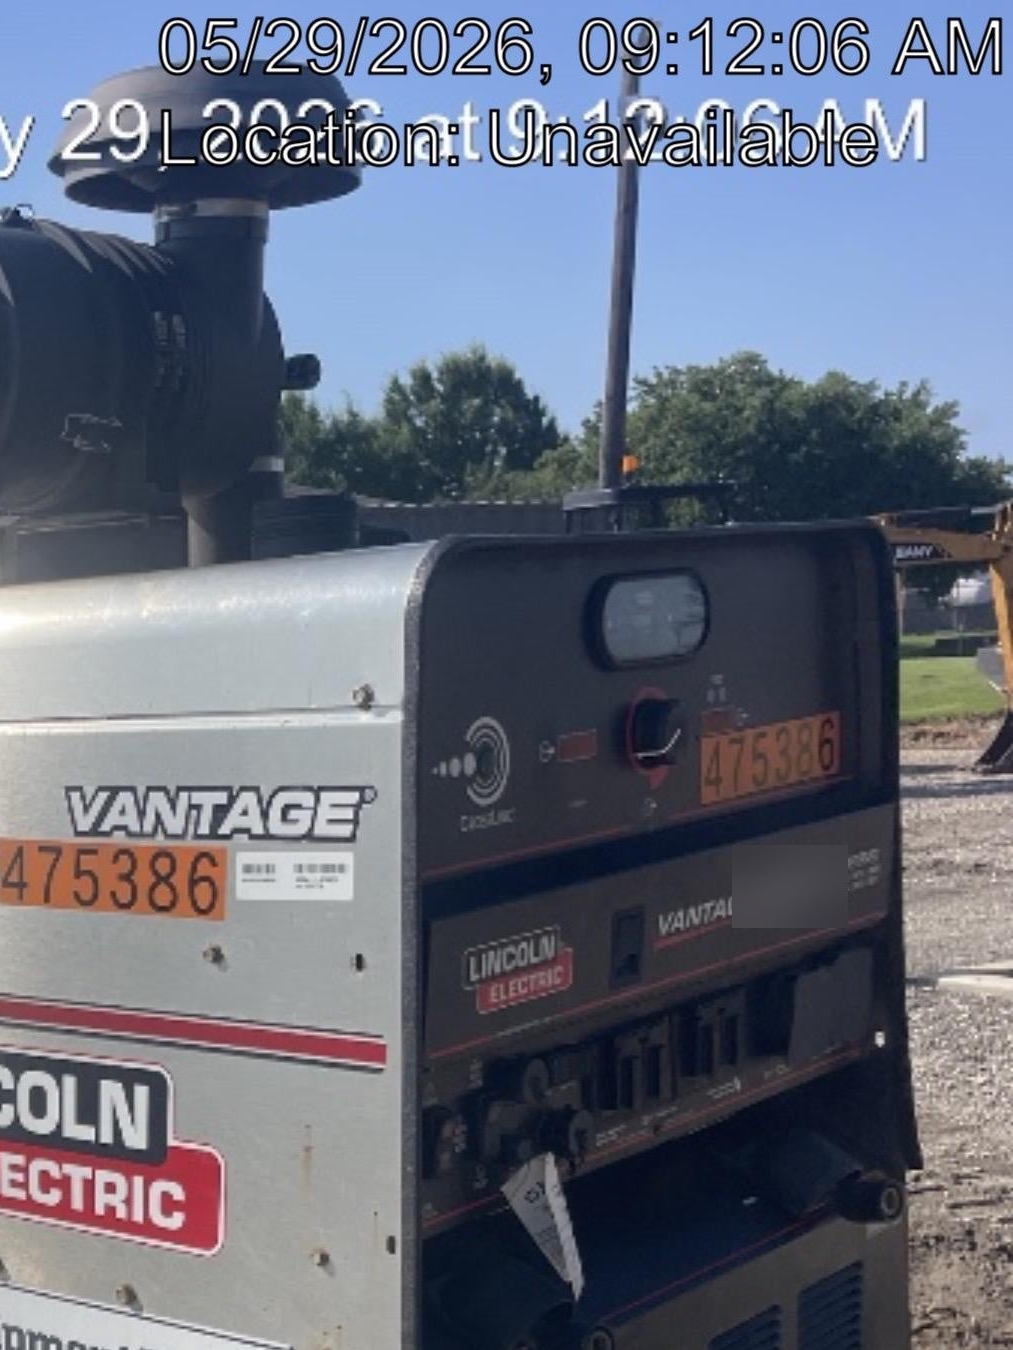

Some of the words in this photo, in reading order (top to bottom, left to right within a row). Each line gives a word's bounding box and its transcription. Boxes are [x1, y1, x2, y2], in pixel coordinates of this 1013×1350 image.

[704, 716, 835, 794] 475386
[66, 785, 363, 844] VANTAGE
[1, 844, 220, 916] 475386
[468, 934, 556, 982] LINCOLN
[489, 965, 564, 1003] ELECTRIC
